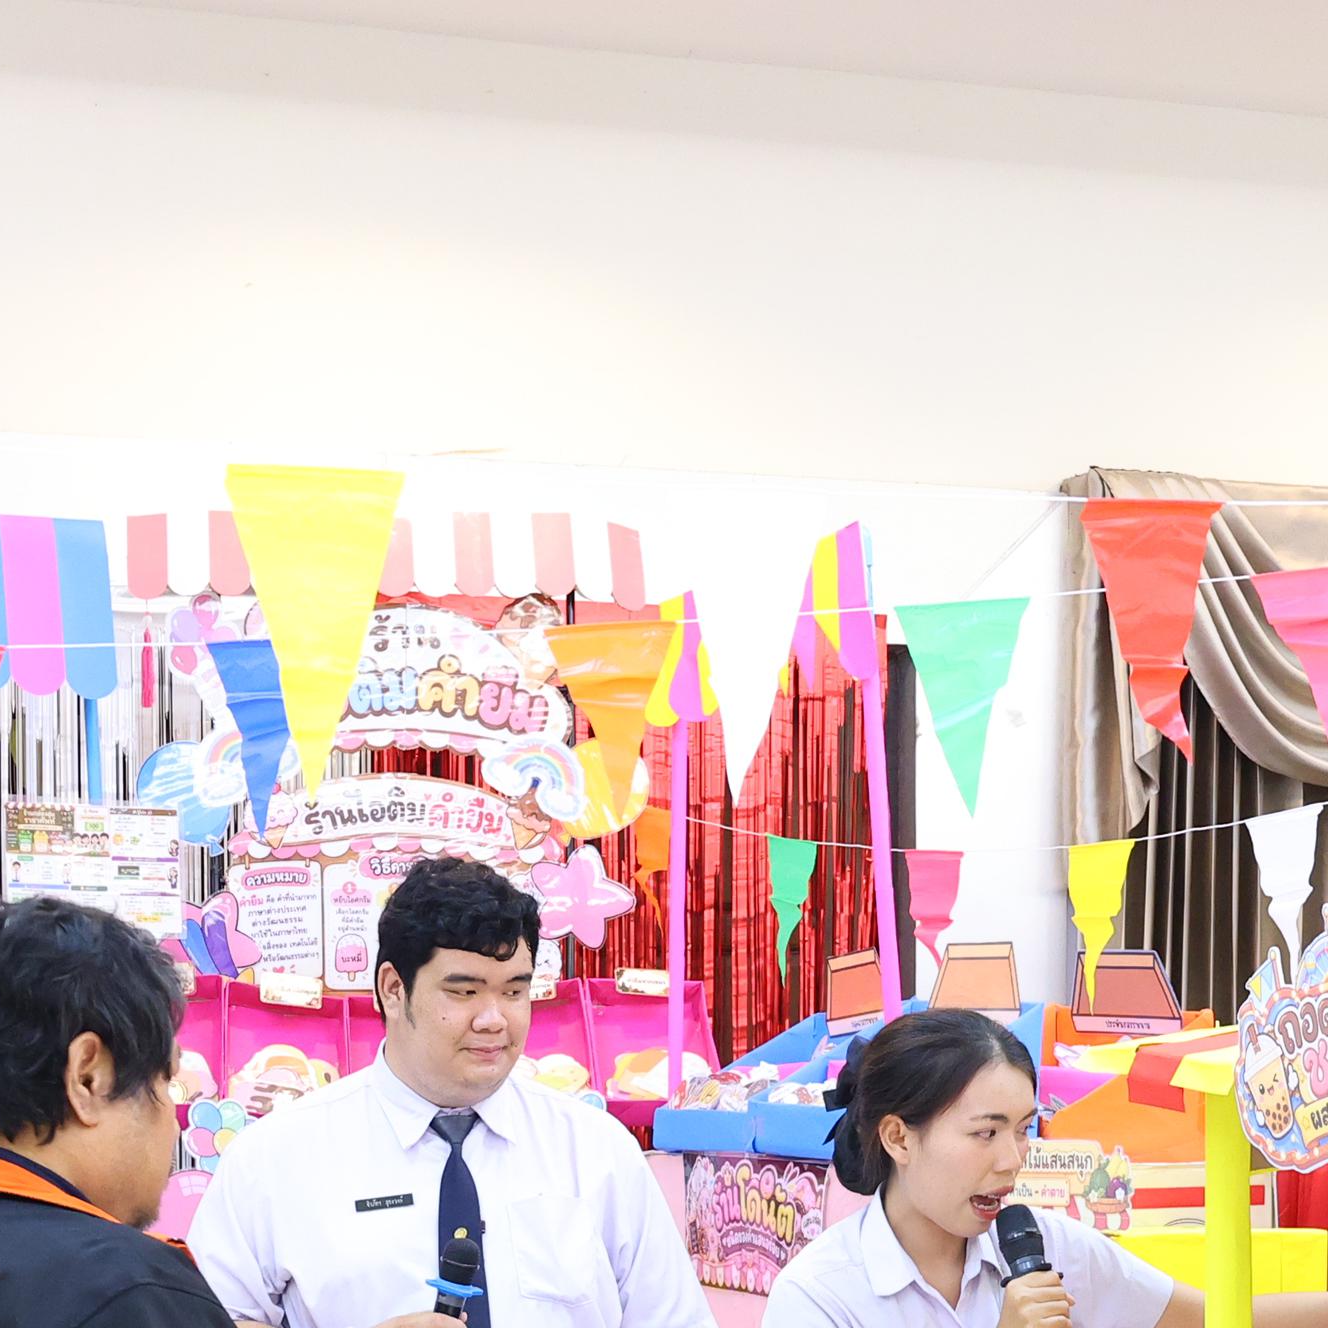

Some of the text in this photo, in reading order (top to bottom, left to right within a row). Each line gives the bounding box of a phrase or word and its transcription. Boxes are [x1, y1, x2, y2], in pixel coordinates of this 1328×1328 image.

[369, 855, 417, 876] วิธีการ
[245, 872, 307, 887] ความหมาย
[240, 895, 263, 907] คำยืม
[1023, 1147, 1093, 1177] ไม้แสนสนุก
[1009, 1183, 1033, 1197] ำเป็น
